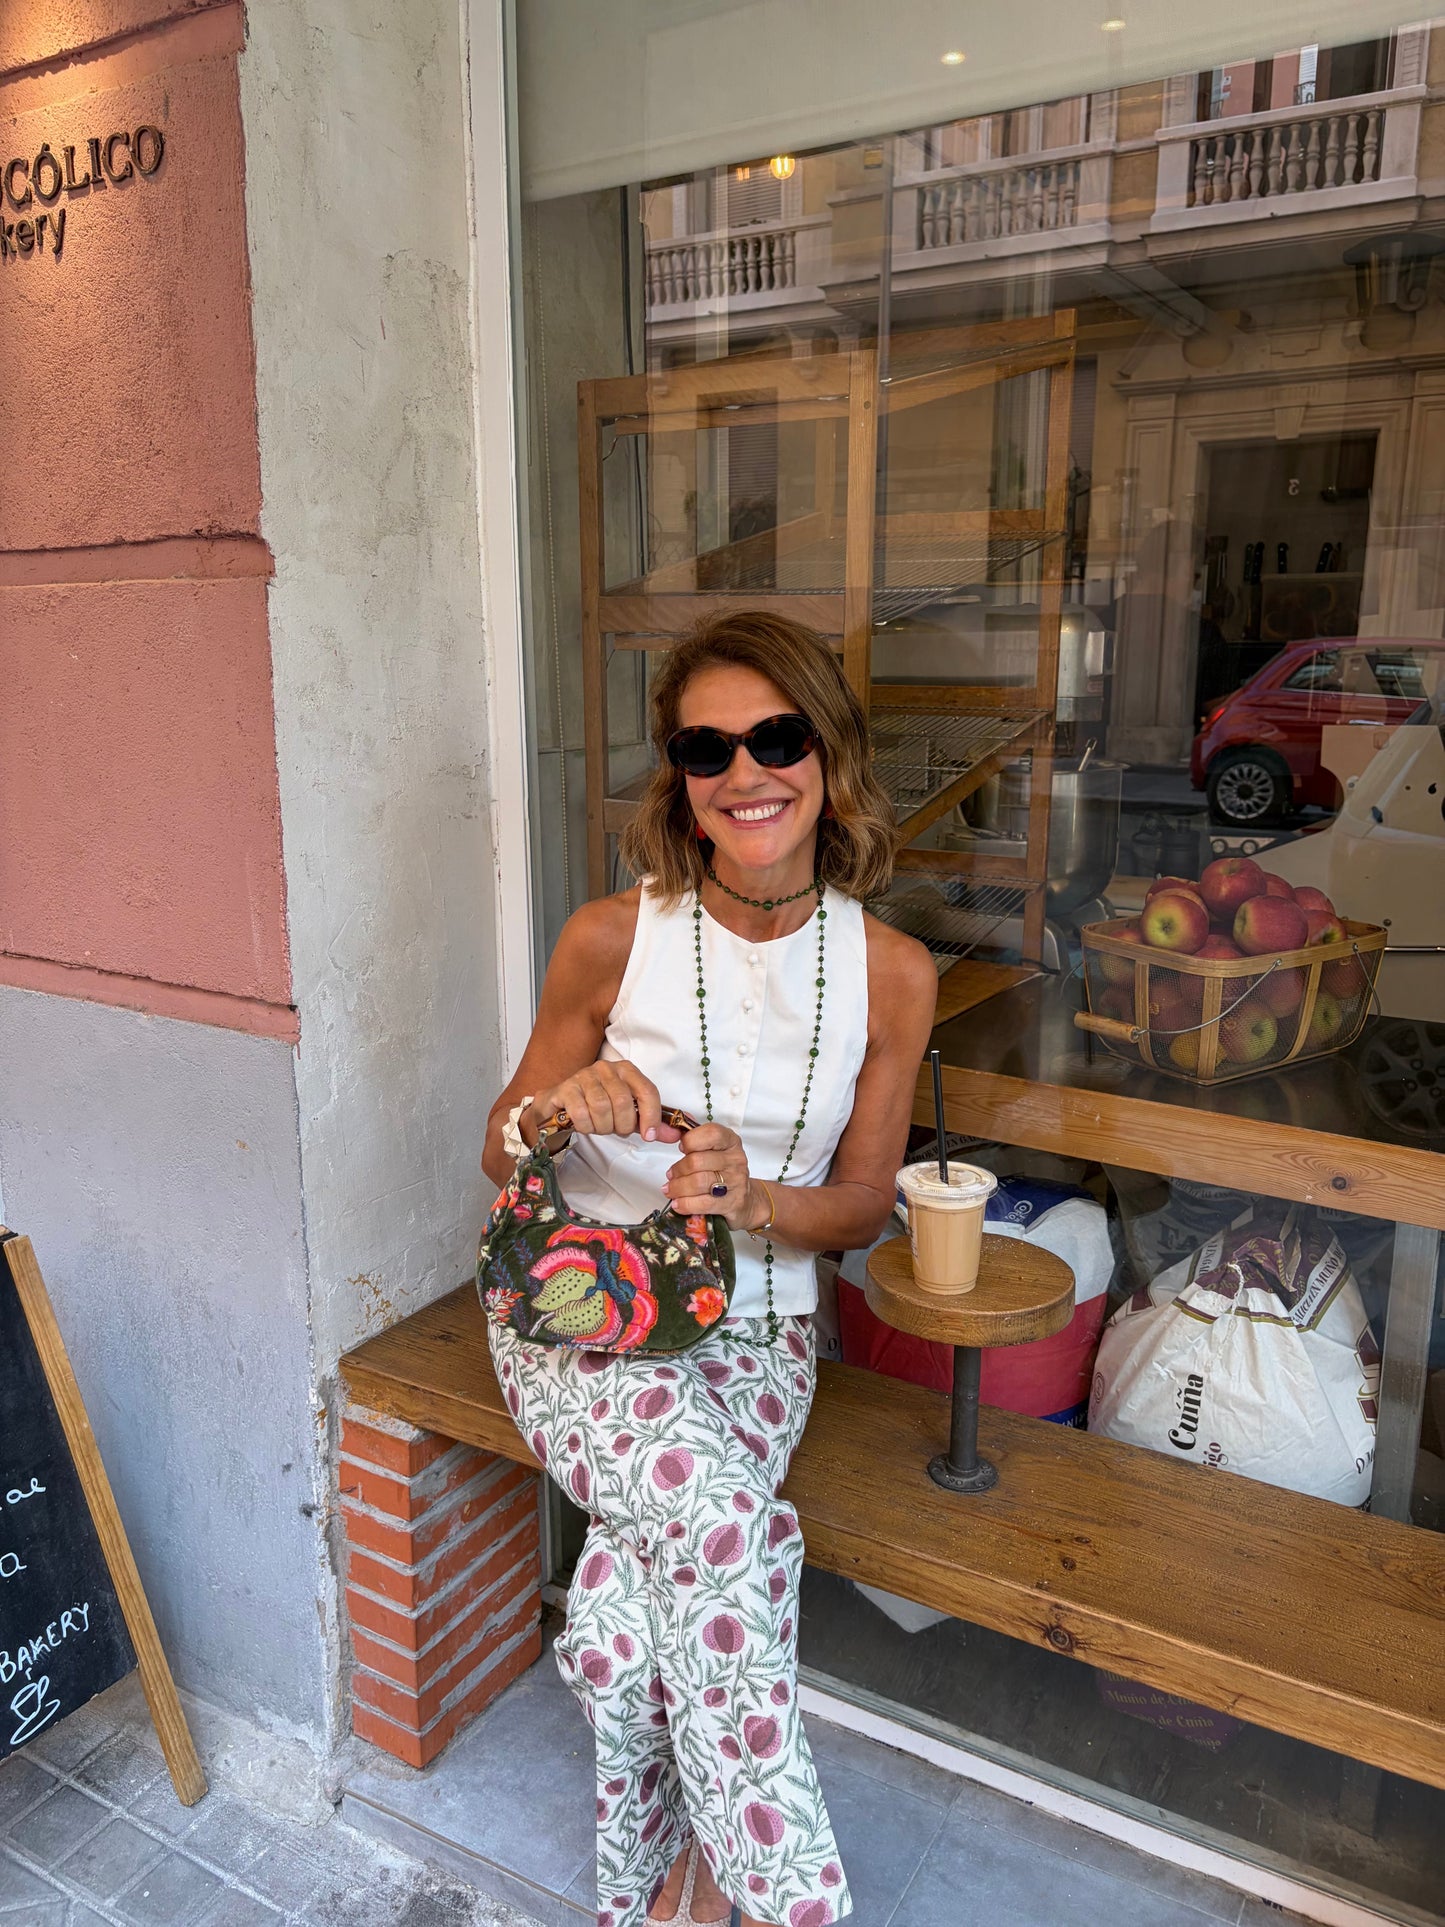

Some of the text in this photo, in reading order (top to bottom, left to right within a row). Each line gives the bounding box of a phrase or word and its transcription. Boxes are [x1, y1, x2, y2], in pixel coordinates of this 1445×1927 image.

[0, 125, 165, 208] CÓLICO
[0, 208, 66, 255] kery
[1167, 1372, 1204, 1450] Cuíña
[0, 1602, 90, 1683] BAKERY
